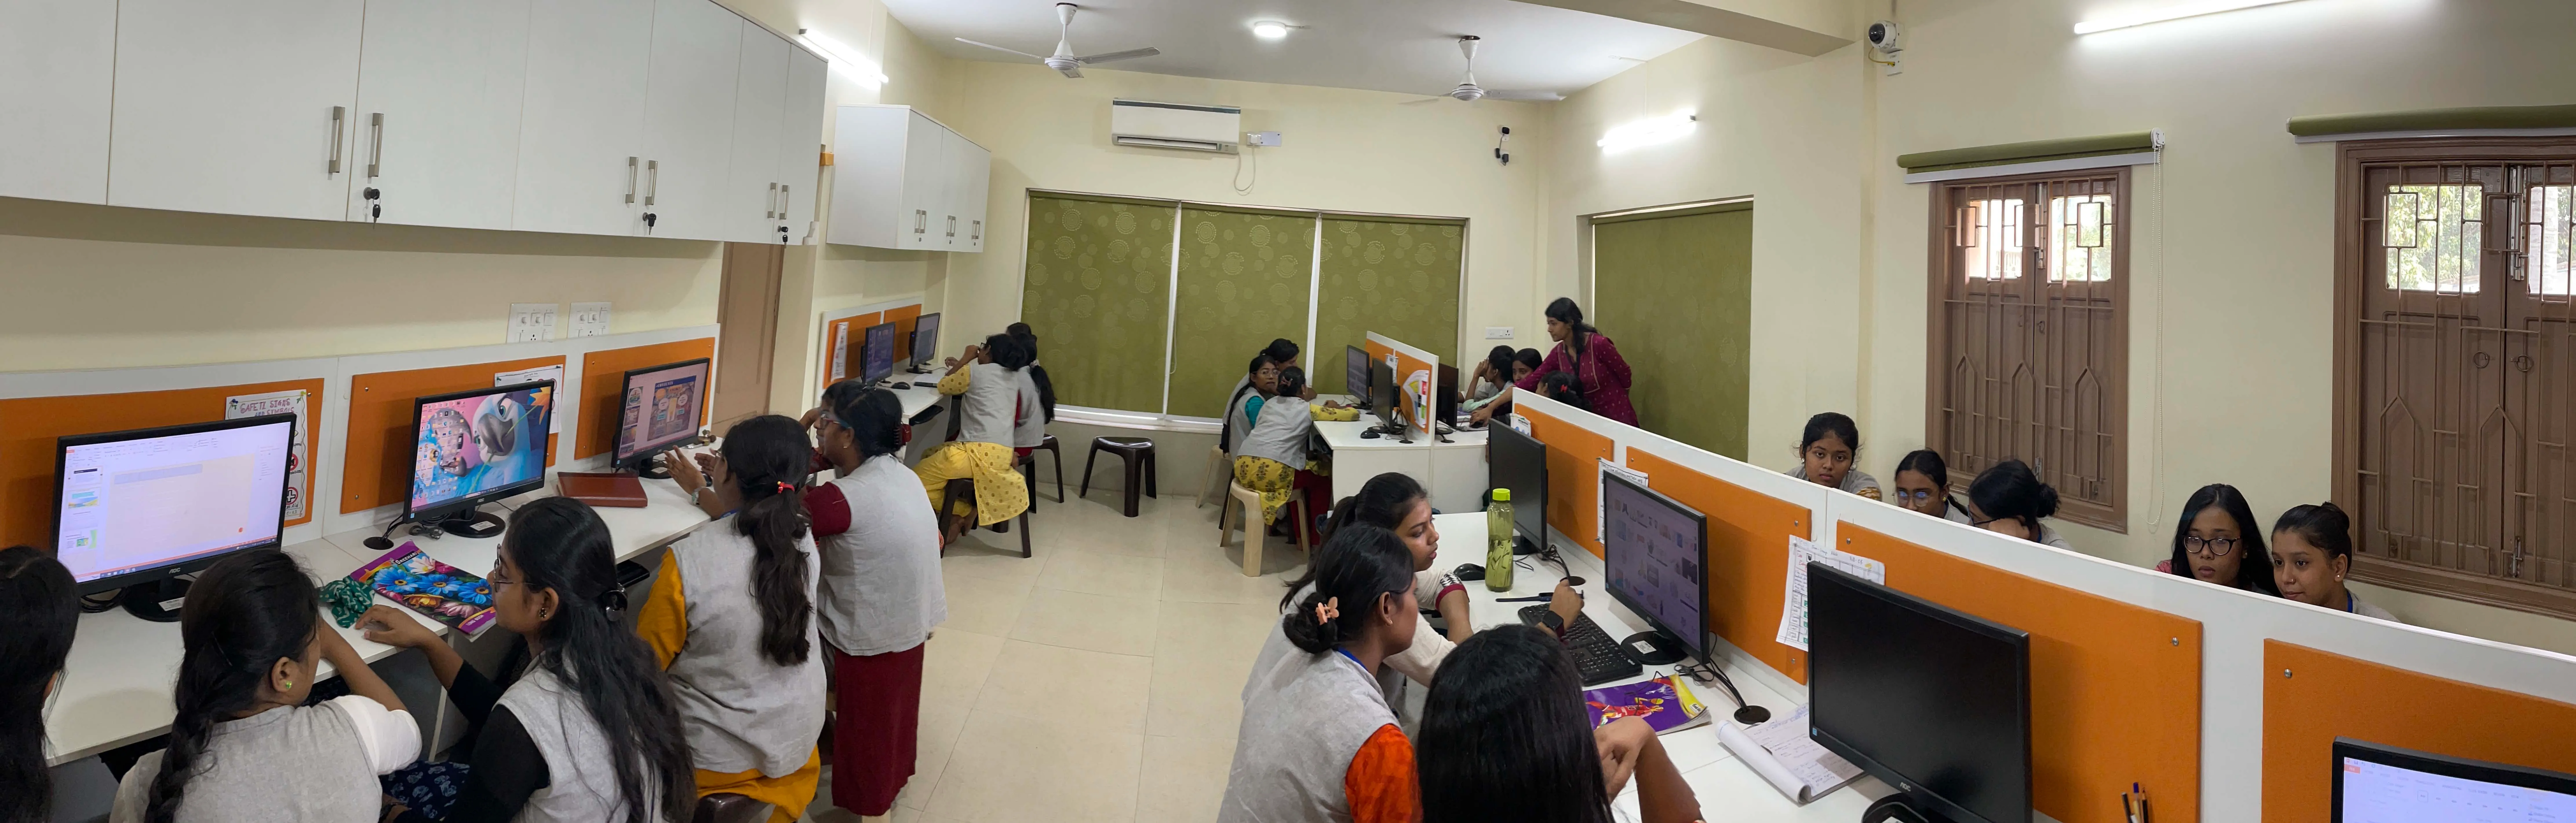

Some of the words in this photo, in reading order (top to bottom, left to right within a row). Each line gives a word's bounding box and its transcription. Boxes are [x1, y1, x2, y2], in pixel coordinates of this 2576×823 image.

[270, 398, 290, 408] SIGNS
[395, 552, 418, 564] SREEHARI
[1900, 782, 1911, 792] AOC
